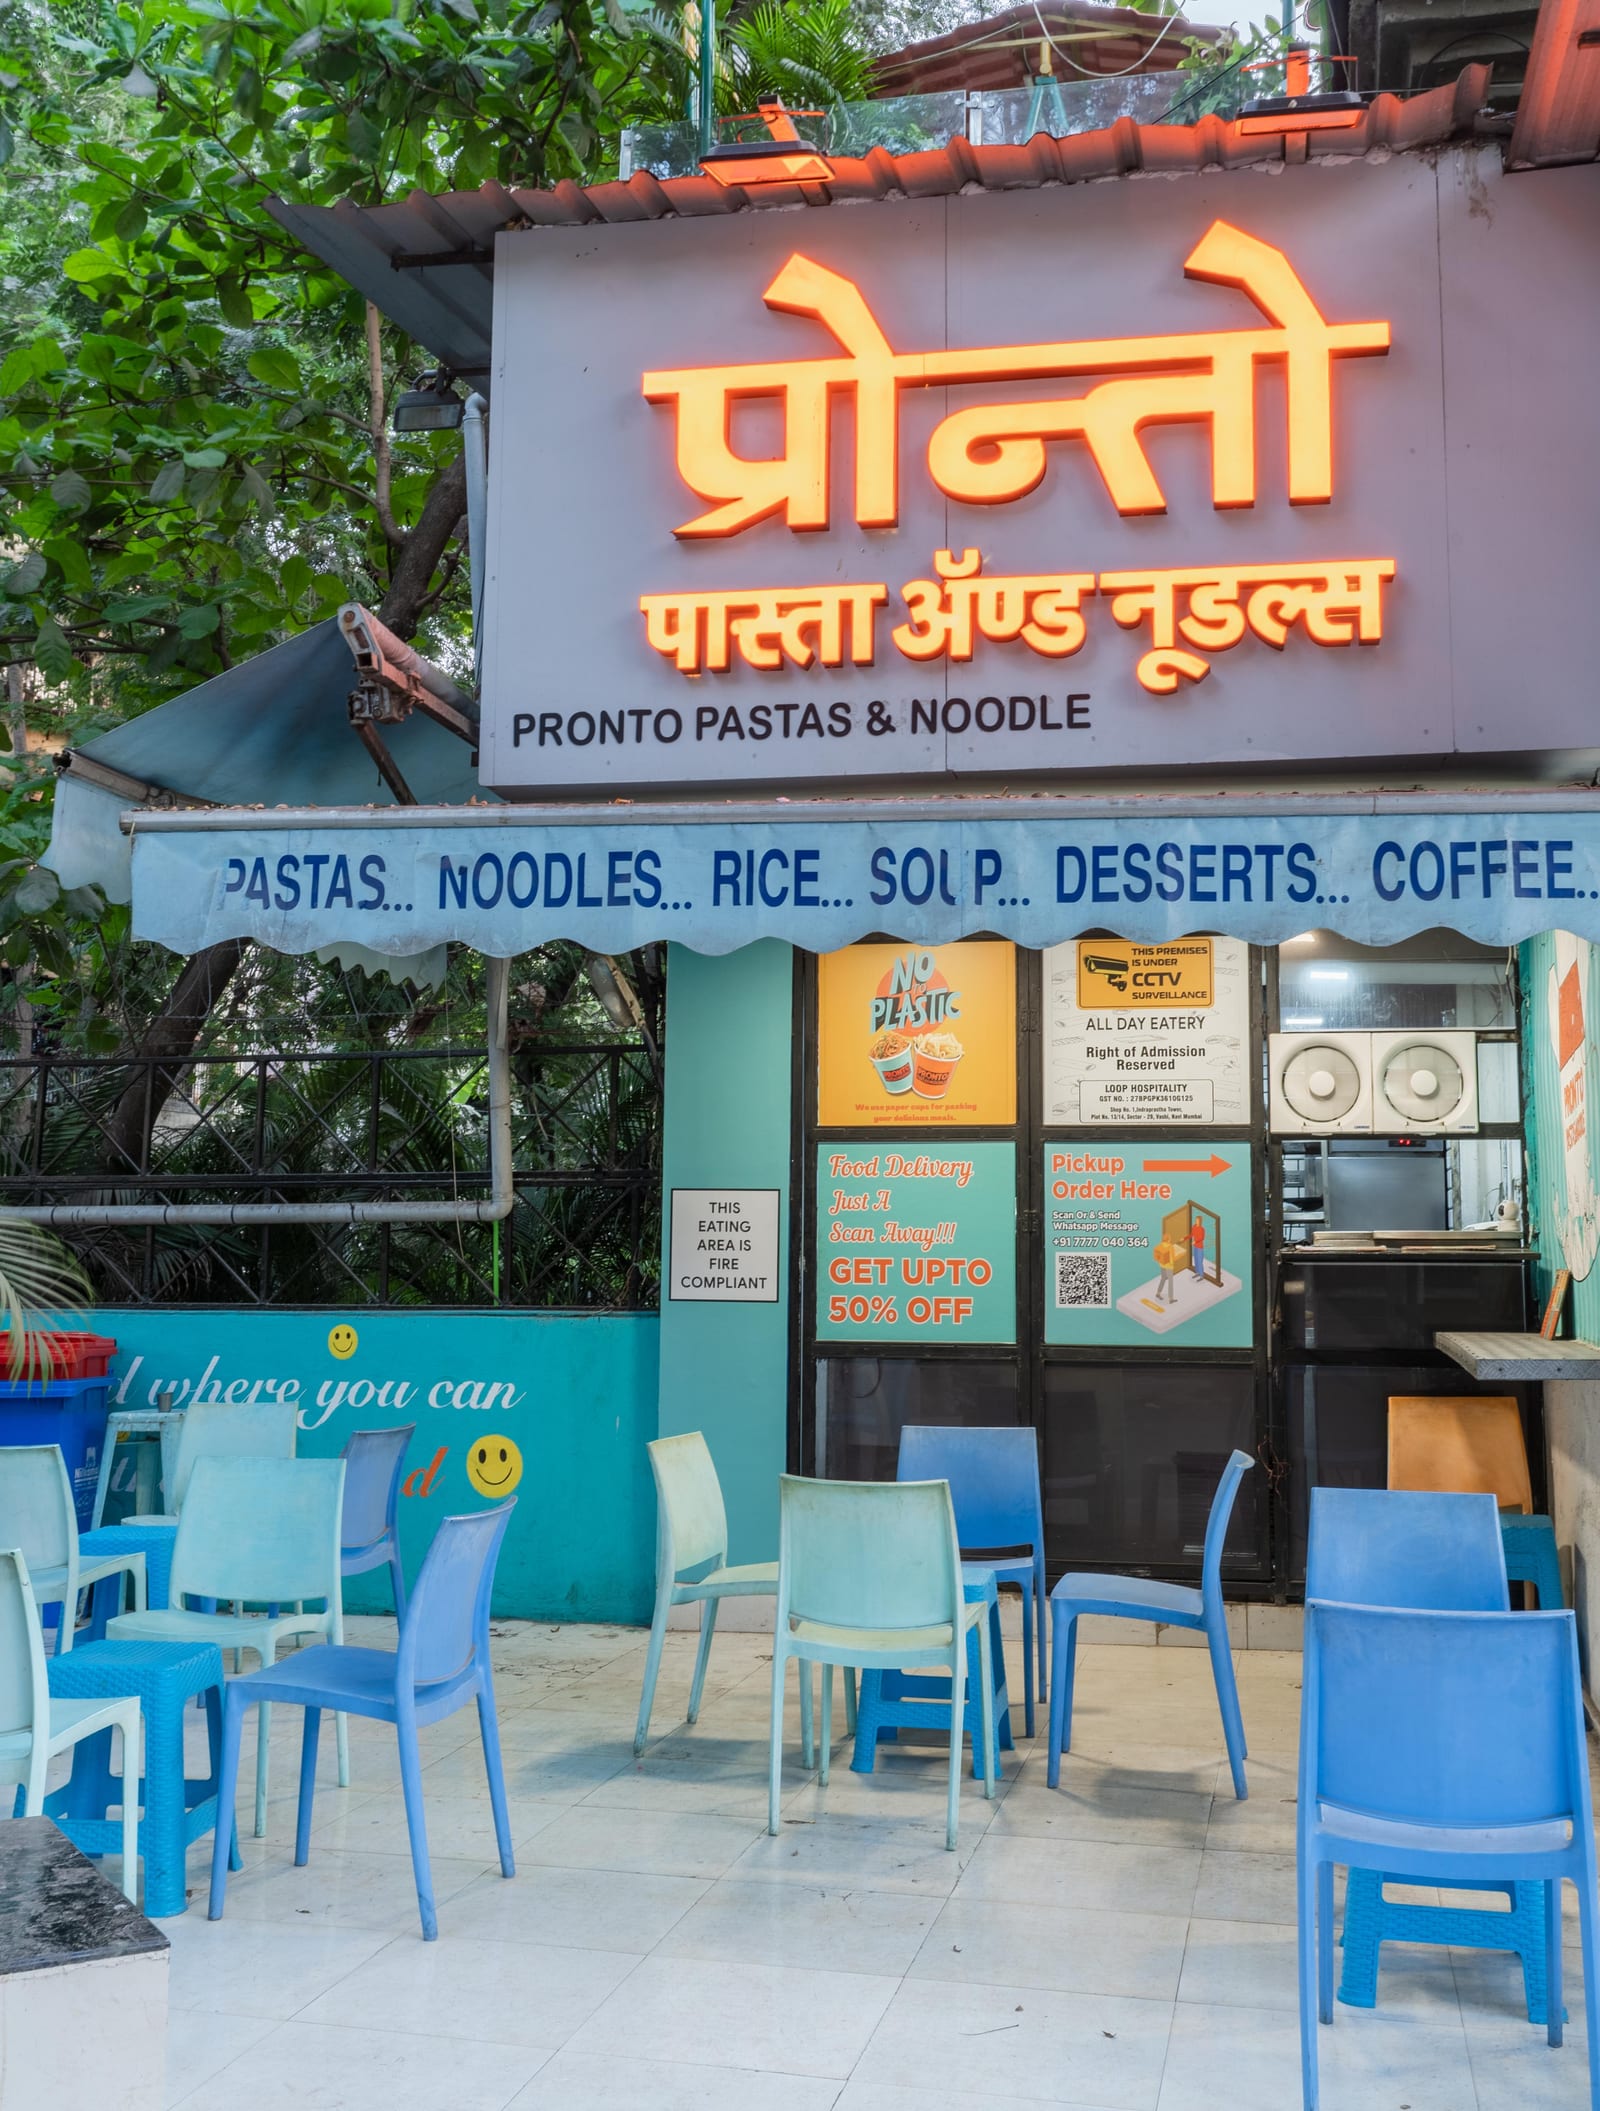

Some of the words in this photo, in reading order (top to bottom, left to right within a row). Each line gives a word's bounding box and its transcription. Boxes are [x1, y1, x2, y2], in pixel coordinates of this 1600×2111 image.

[642, 219, 1391, 541] प्रोन्तो
[639, 583, 889, 675] पास्ता
[1099, 558, 1397, 694] नूडल्स
[512, 707, 684, 748] PRONTO
[695, 701, 853, 742] PASTAS
[866, 699, 897, 736] &
[910, 693, 1093, 734] NOODLE
[439, 849, 692, 910] NOODLES...
[712, 848, 853, 907] RICE...
[1056, 842, 1350, 904] DESSERTS...
[1132, 947, 1155, 956] THIS
[1156, 946, 1208, 955] PREMISES
[1132, 958, 1142, 966] IS
[1143, 958, 1178, 966] UNDER
[889, 952, 936, 995] NO
[1132, 972, 1182, 987] CCTV
[1132, 991, 1208, 1000] SURVEILLANCE
[869, 987, 964, 1035] PLASTIC
[1086, 1017, 1113, 1031] ALL
[1117, 1017, 1146, 1030] DAY
[1150, 1016, 1206, 1030] EATERY
[1086, 1046, 1119, 1060] Right
[1123, 1046, 1136, 1057] of
[1140, 1045, 1206, 1058] Admission
[1116, 1058, 1176, 1070] Reserved
[1105, 1084, 1128, 1093] LOOP
[1130, 1083, 1188, 1093] HOSPITALITY
[855, 1103, 869, 1111] We
[886, 1104, 909, 1112] paper
[911, 1104, 930, 1112] cups
[931, 1103, 944, 1111] for
[873, 1115, 892, 1123] your
[893, 1113, 929, 1121] delicious
[829, 1153, 880, 1178] Food
[884, 1153, 974, 1187] Delivery
[1052, 1153, 1125, 1176] Pickup
[1052, 1180, 1114, 1199] Order
[1121, 1180, 1171, 1199] Here
[709, 1202, 741, 1214] THIS
[829, 1190, 870, 1215] Just
[873, 1190, 892, 1211] A
[1052, 1211, 1074, 1219] Scan
[1089, 1211, 1096, 1219] &
[1097, 1210, 1121, 1219] Send
[698, 1220, 752, 1233] EATING
[1052, 1221, 1098, 1232] Whatsapp
[1100, 1222, 1139, 1232] Message
[829, 1221, 875, 1243] Scan
[880, 1221, 957, 1252] Away!!!
[1052, 1237, 1071, 1247] +91
[1073, 1237, 1099, 1247] 7777
[1101, 1237, 1125, 1247] 040
[1127, 1237, 1149, 1247] 364
[697, 1239, 736, 1251] AREA
[739, 1239, 752, 1251] IS
[709, 1258, 740, 1270] FIRE
[829, 1257, 894, 1285] GET
[902, 1257, 993, 1287] UPTO
[681, 1276, 768, 1289] COMPLIANT
[828, 1295, 898, 1324] 50%
[907, 1296, 974, 1325] OFF
[147, 1355, 305, 1406] where
[296, 1379, 419, 1431] you
[427, 1379, 527, 1410] can
